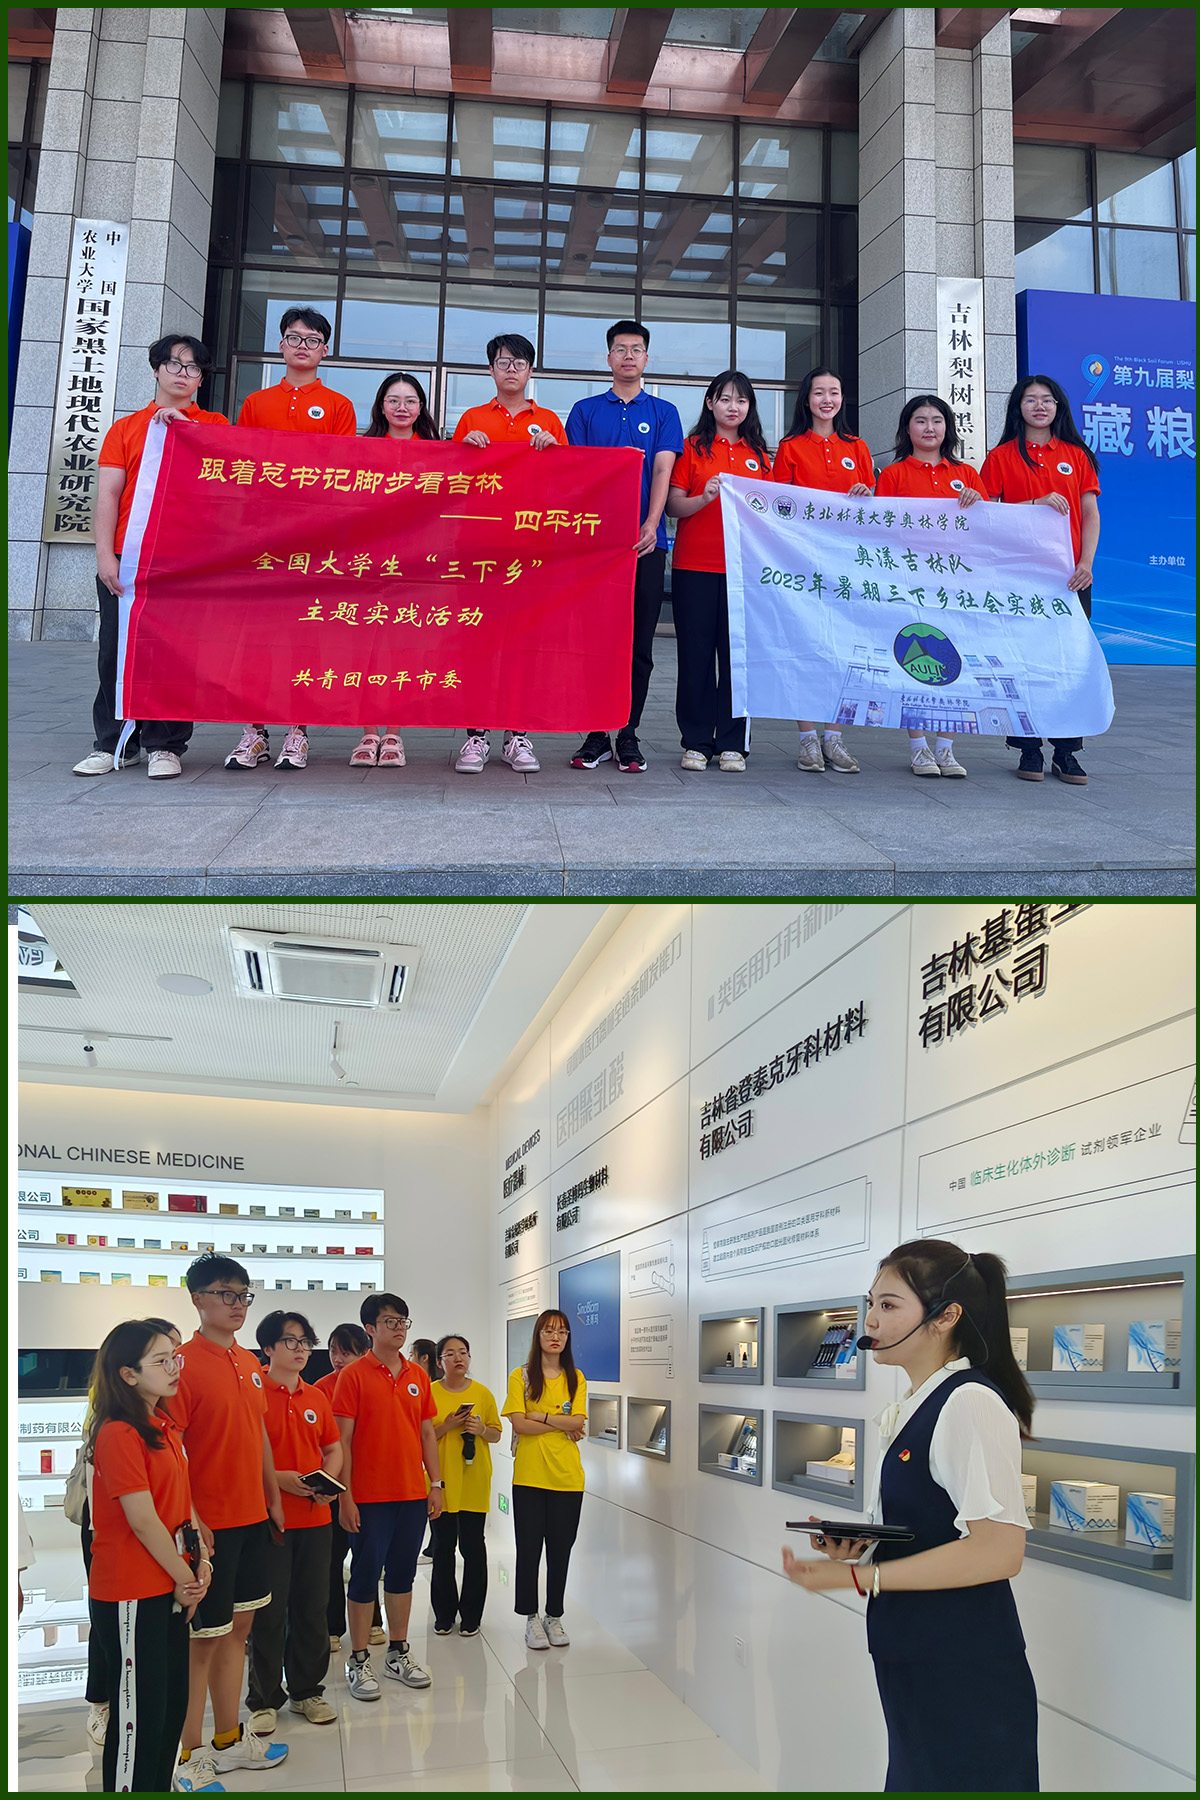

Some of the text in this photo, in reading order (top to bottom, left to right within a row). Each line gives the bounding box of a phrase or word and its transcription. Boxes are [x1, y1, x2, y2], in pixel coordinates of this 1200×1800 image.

[76, 230, 97, 294] 农业大学
[1113, 365, 1195, 390] 第九届梨
[54, 298, 111, 533] 国家黑土地现代农业研究院
[1082, 402, 1196, 459] 藏粮
[198, 457, 504, 496] 跟着总书记脚步看吉林
[854, 543, 973, 576] 奥漾吉林队
[1149, 554, 1186, 567] 主办单位
[298, 598, 484, 627] 主题实践活动
[760, 566, 1074, 619] 2023年暑期三下乡社会实践团
[291, 668, 462, 691] 共青团四平市委
[920, 904, 1094, 1001] 吉林基蛋
[918, 942, 1049, 1049] 有限公司
[700, 1000, 868, 1130] 吉林省登泰克牙科材料
[66, 1146, 151, 1165] CHINESE
[156, 1152, 245, 1171] MEDICINE
[699, 1109, 754, 1161] 有限公司
[949, 1122, 1162, 1191] 中国 临床生化体外诊断 试剂领军企业
